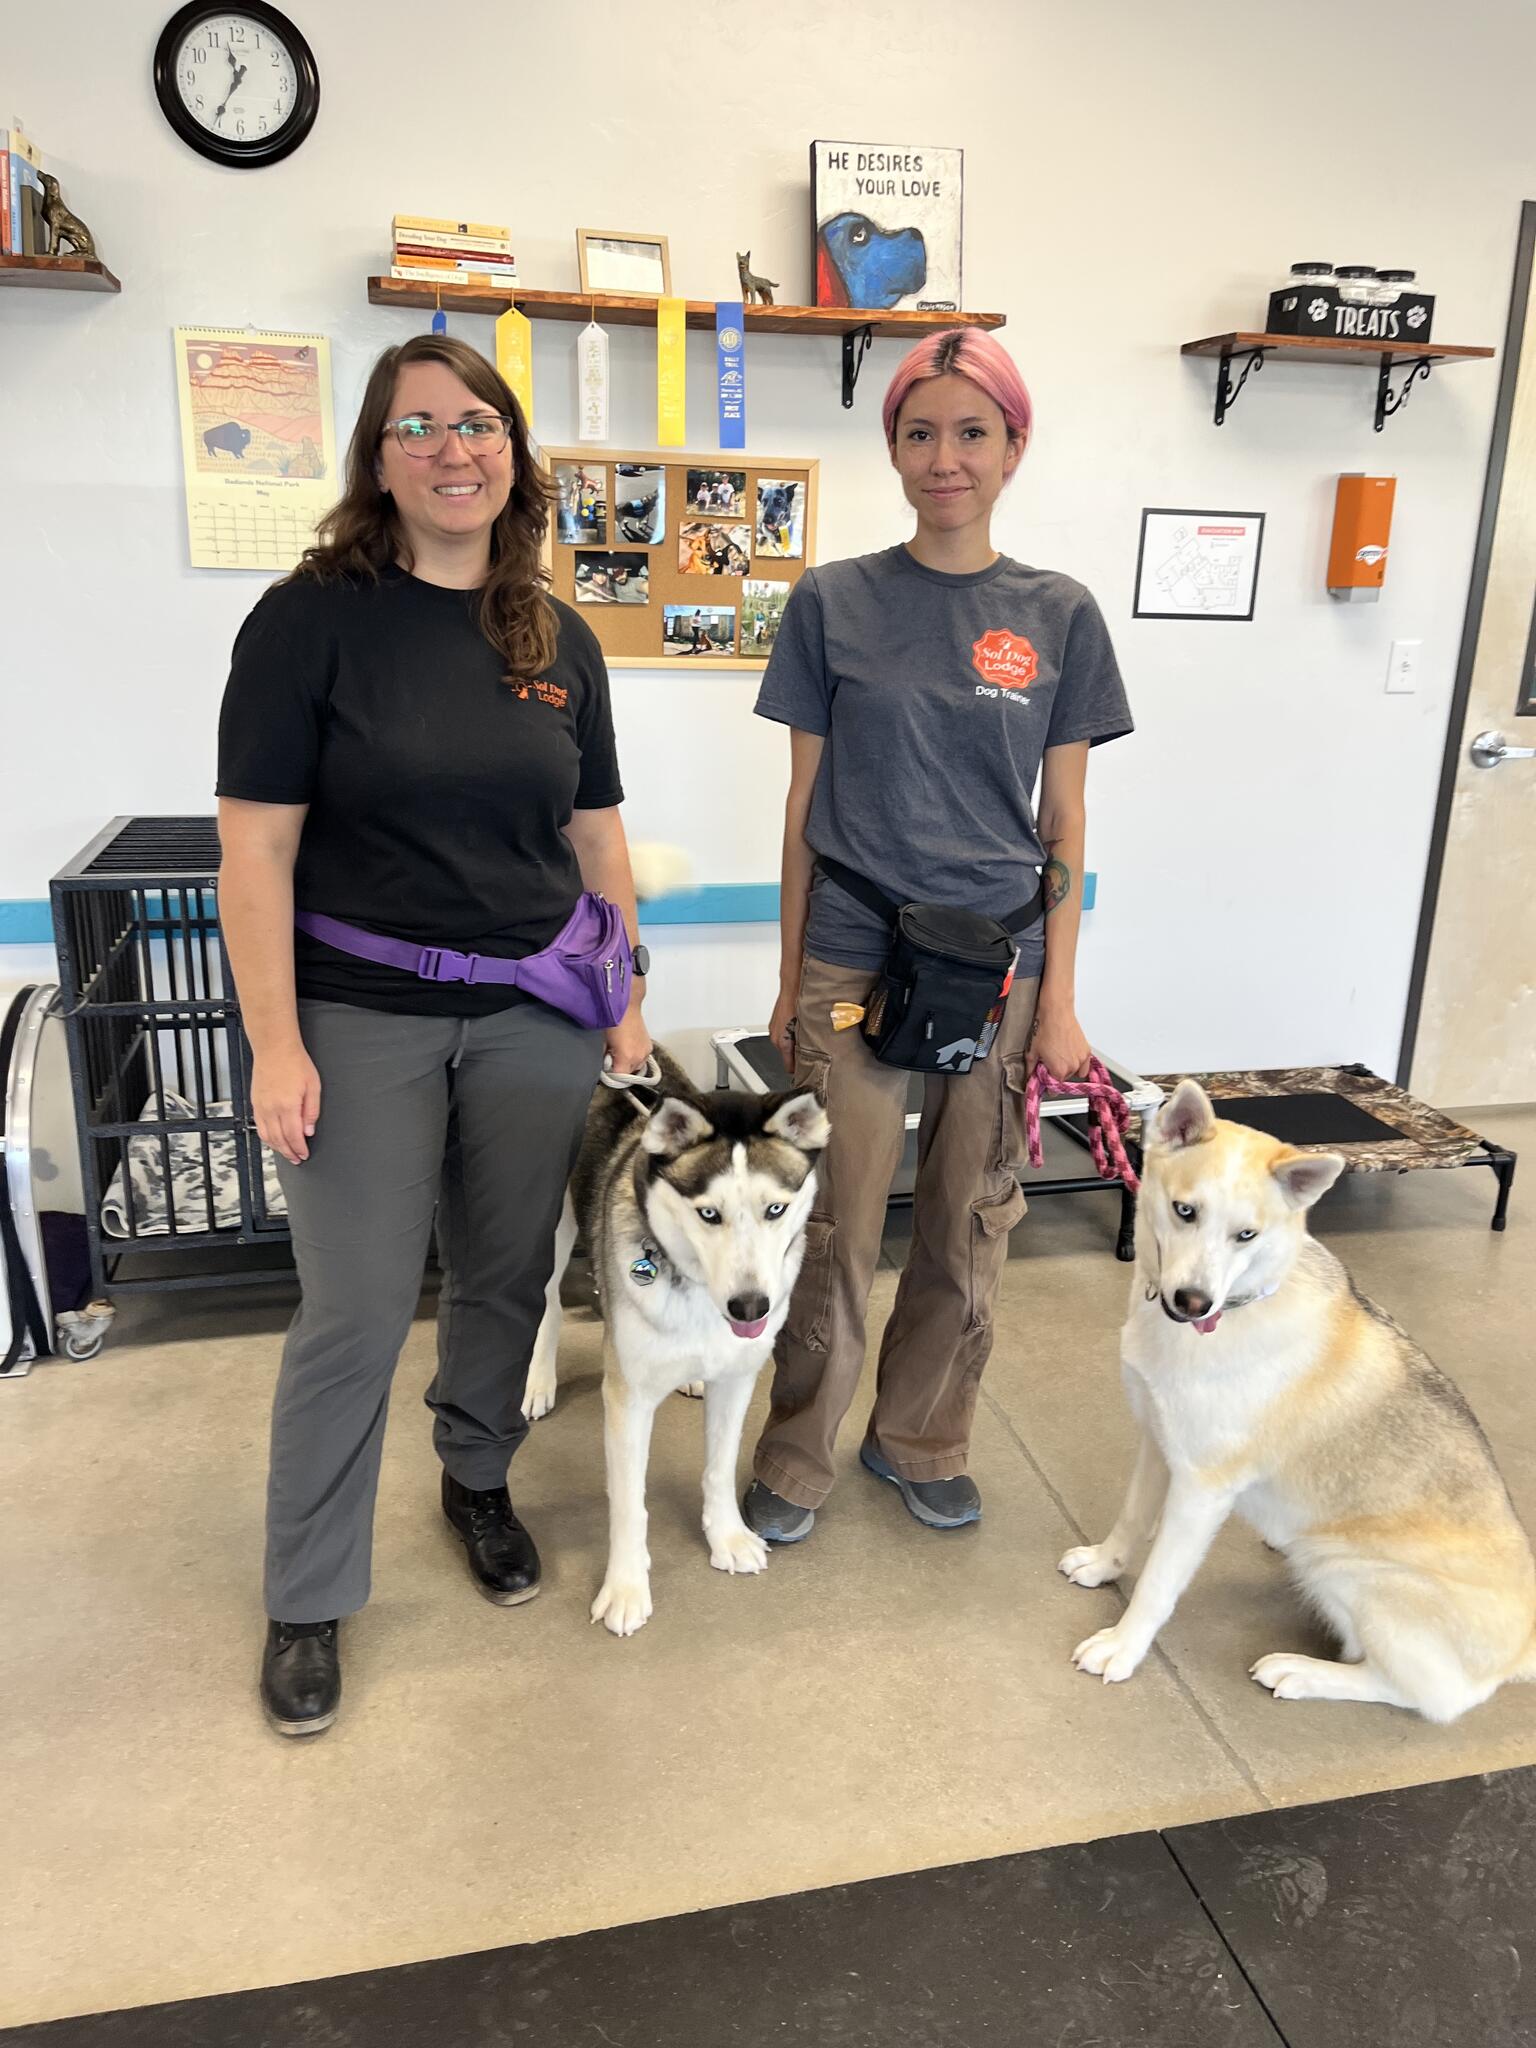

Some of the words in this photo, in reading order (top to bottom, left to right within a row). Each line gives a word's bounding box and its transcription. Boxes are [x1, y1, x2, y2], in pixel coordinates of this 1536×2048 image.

[208, 32, 219, 48] 11
[229, 26, 245, 42] 12
[255, 34, 261, 49] 1
[192, 48, 207, 64] 10
[270, 52, 279, 67] 2
[187, 70, 195, 85] 9
[279, 77, 288, 92] 3
[195, 95, 204, 110] 8
[273, 99, 281, 115] 4
[236, 120, 245, 135] 6
[259, 116, 267, 131] 5
[828, 151, 850, 170] HE
[857, 153, 924, 172] DESIRES
[856, 178, 896, 196] YOUR
[902, 180, 941, 197] LOVE
[1334, 305, 1401, 339] TREATS
[981, 647, 1003, 660] Sol
[1006, 650, 1032, 667] Dog
[984, 660, 1027, 676] Lodge
[549, 683, 568, 699] Dog
[975, 685, 998, 698] Dog
[1000, 688, 1031, 706] Trainer
[537, 691, 566, 708] Lodge
